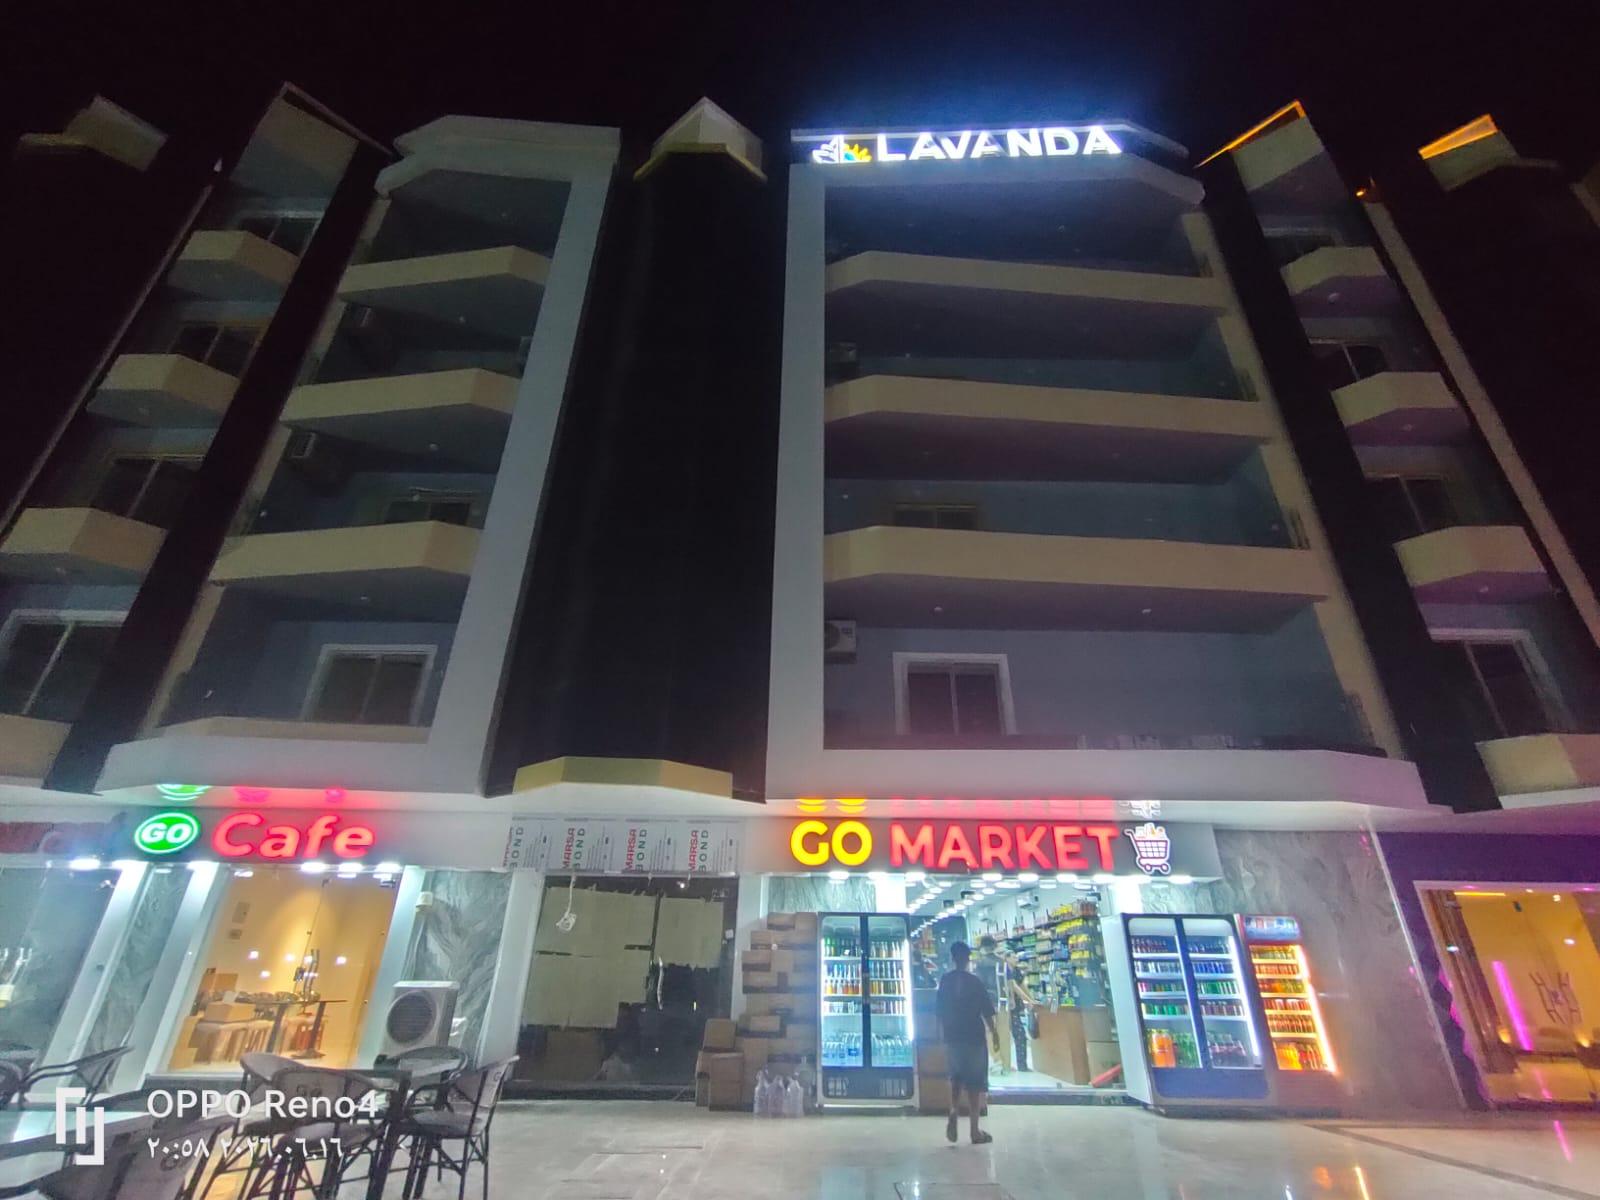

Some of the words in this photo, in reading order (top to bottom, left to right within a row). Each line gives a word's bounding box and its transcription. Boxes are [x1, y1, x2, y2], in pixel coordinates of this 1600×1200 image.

[877, 125, 1122, 161] LAVANDA
[141, 822, 193, 844] GO
[213, 812, 375, 859] Cafe
[790, 819, 873, 868] GO
[889, 823, 1120, 872] MARKET
